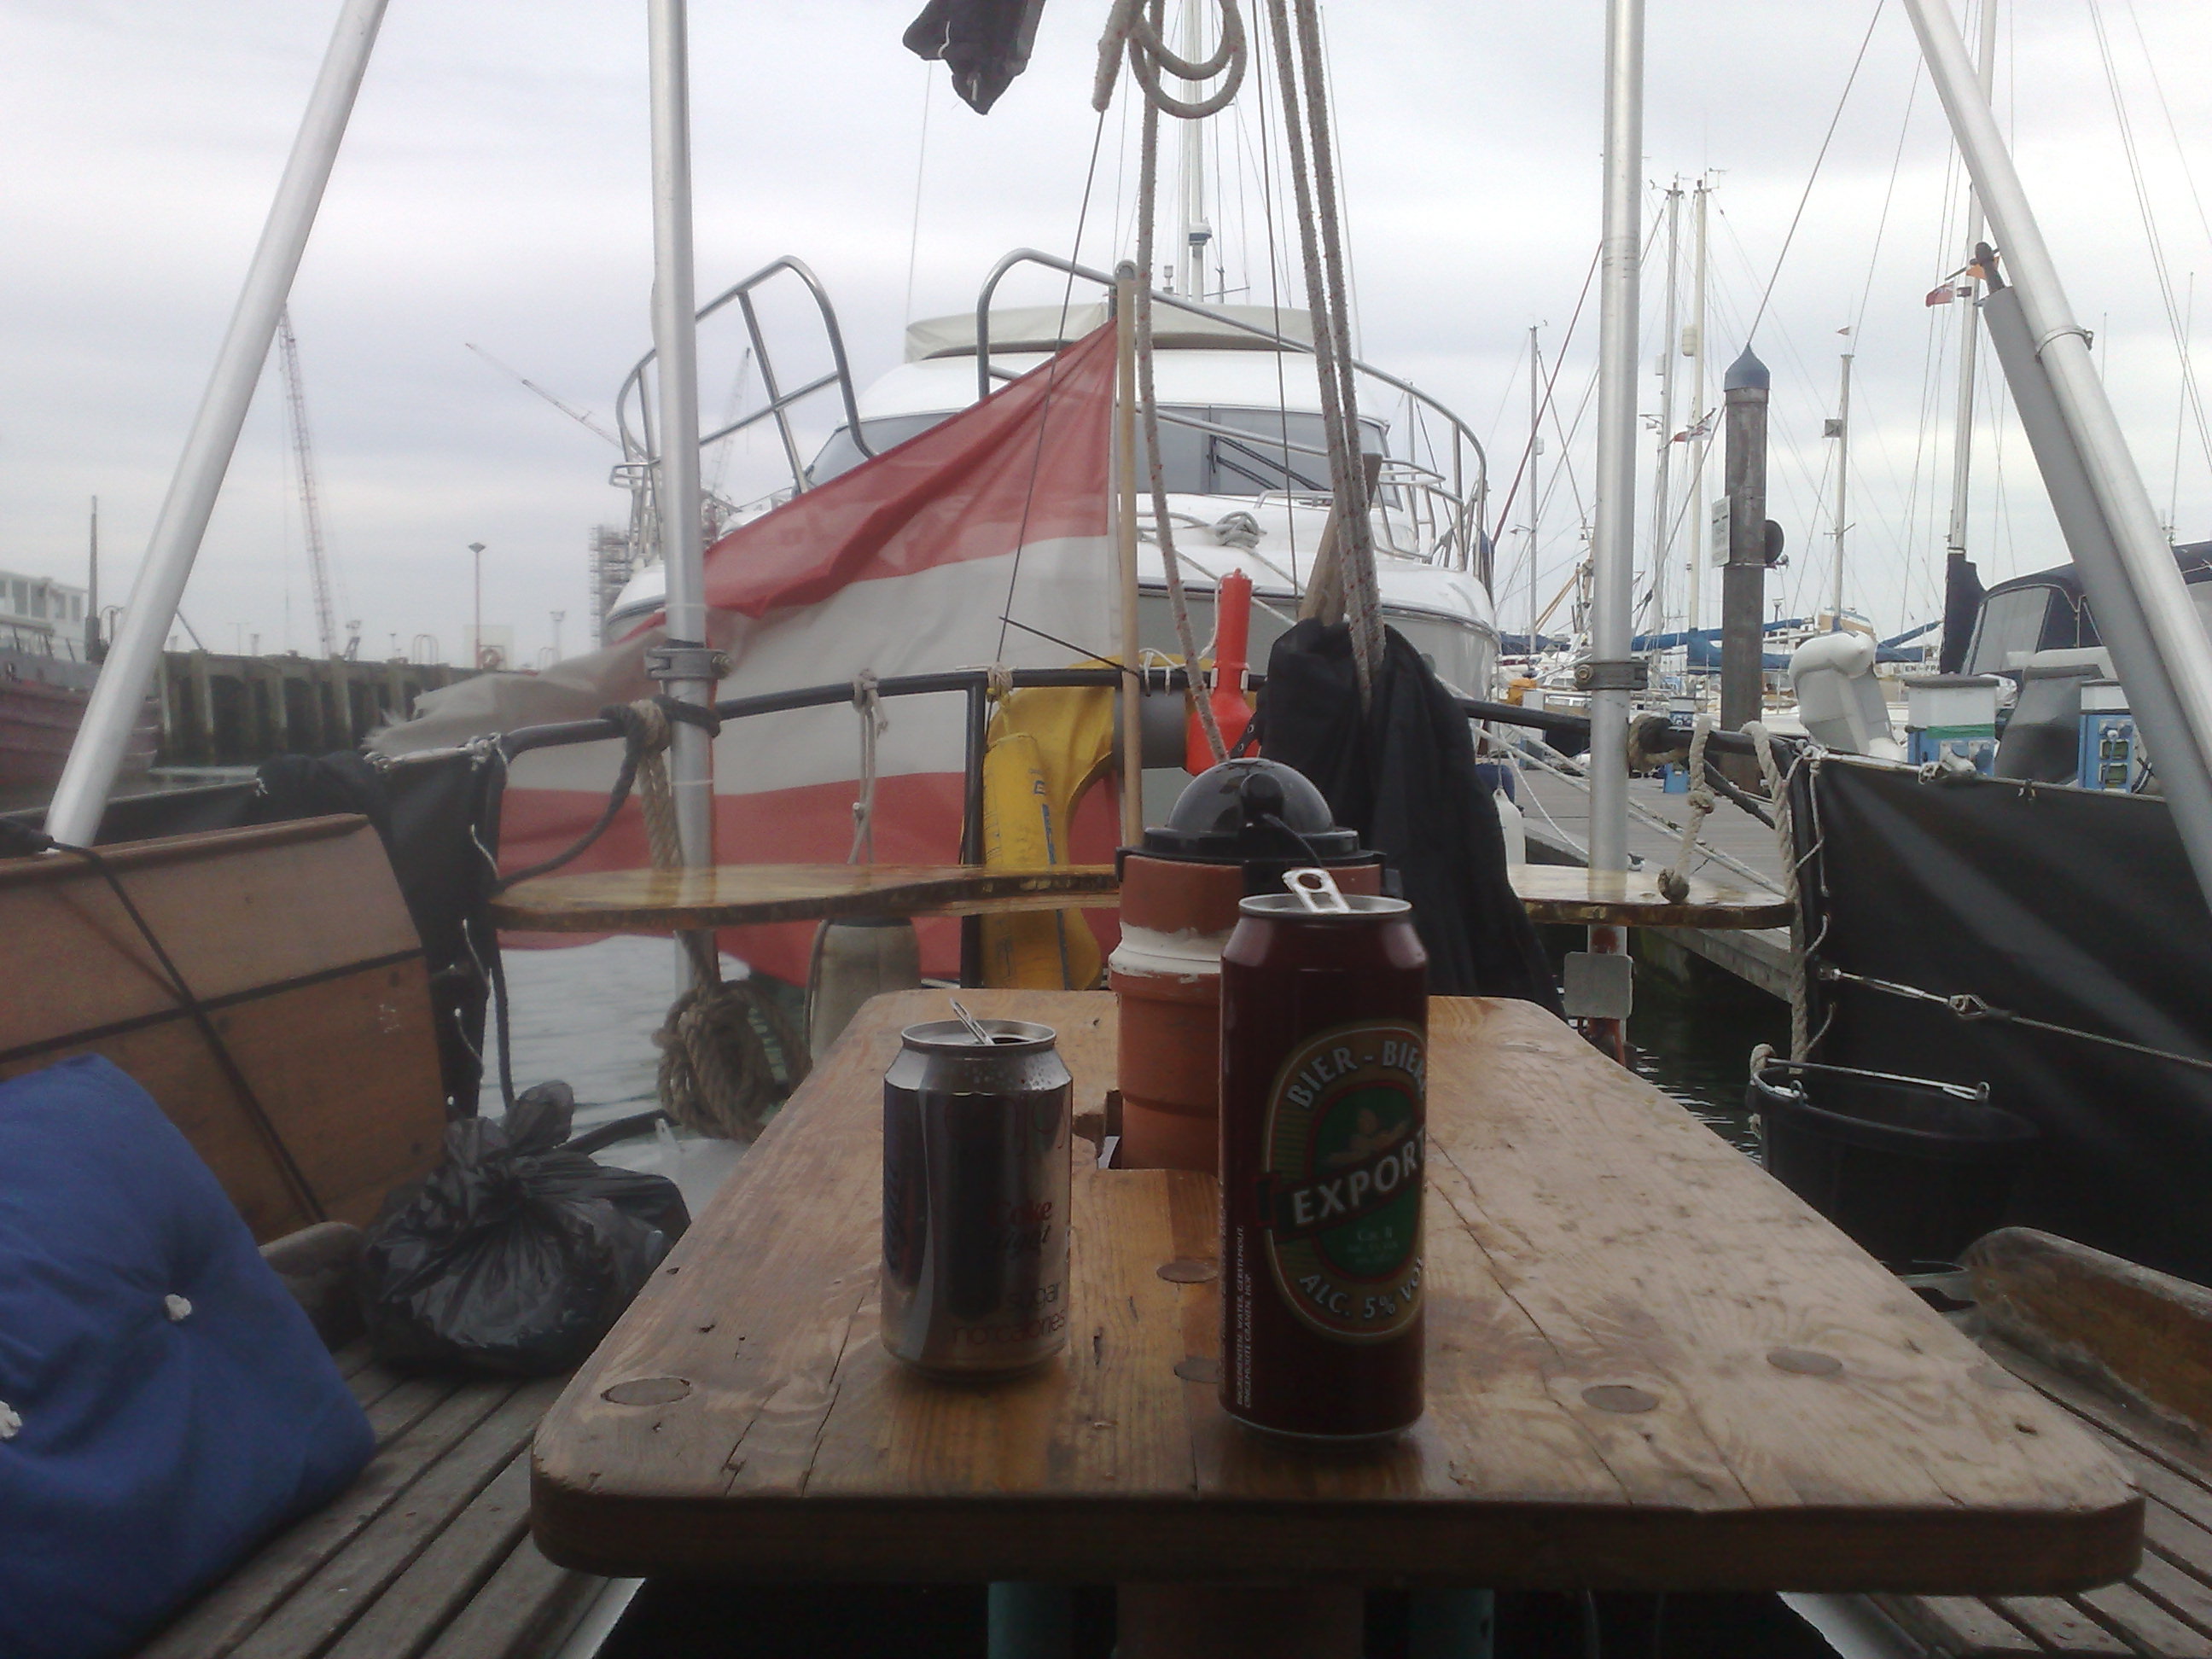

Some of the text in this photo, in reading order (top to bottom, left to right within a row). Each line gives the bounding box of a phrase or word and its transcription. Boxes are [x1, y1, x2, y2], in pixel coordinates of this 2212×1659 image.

[1287, 1045, 1359, 1110] BIER
[1292, 1124, 1426, 1226] EXPORT
[1363, 1295, 1396, 1319] 5%
